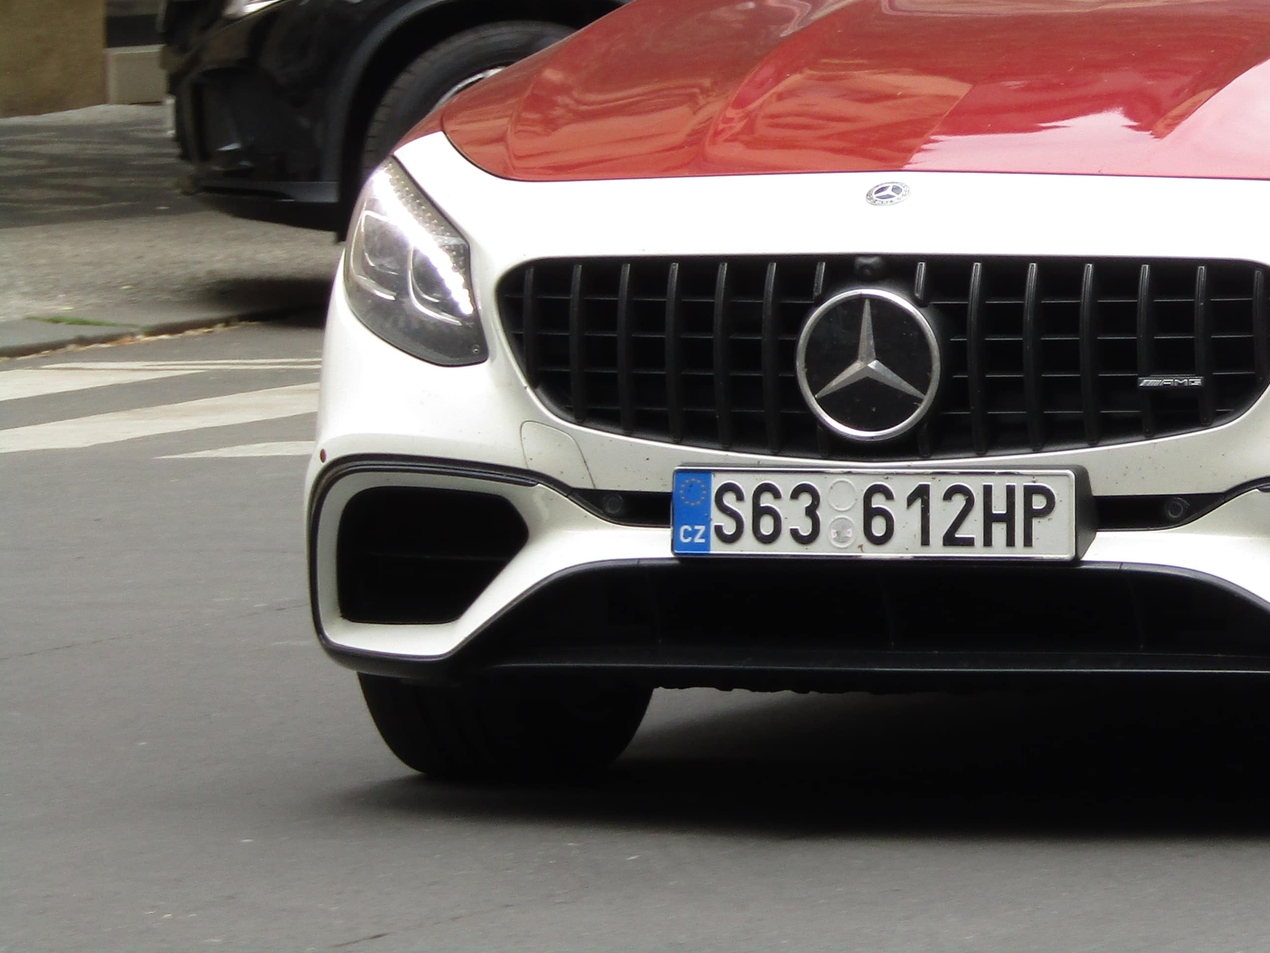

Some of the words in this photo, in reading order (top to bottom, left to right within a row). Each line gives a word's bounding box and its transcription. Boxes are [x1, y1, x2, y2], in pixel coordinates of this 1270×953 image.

[679, 524, 706, 544] CZ
[713, 481, 821, 545] S63
[862, 481, 1057, 548] 612HP
